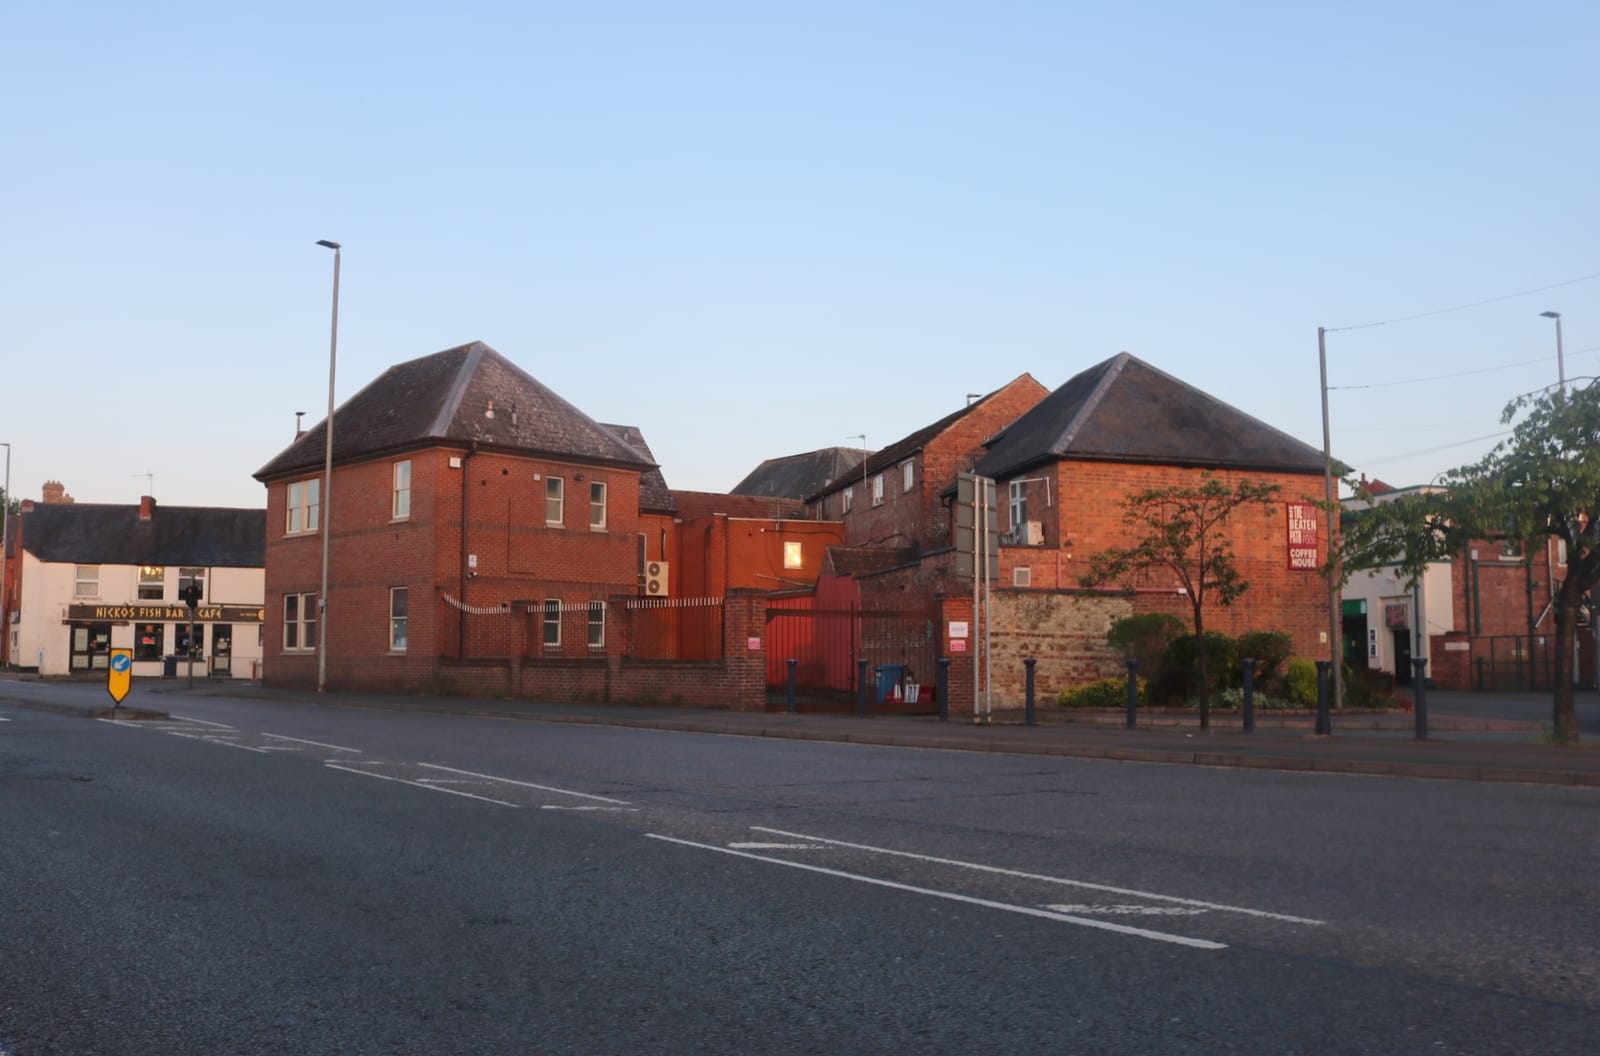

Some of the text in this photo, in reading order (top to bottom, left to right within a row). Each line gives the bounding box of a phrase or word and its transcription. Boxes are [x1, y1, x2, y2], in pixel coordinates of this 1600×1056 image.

[1289, 519, 1316, 531] BEATEN
[1290, 548, 1317, 557] COFFEE
[1292, 557, 1316, 568] HOUSE
[96, 607, 135, 618] NICKOS
[139, 607, 161, 618] FISH
[165, 608, 184, 618] BAR
